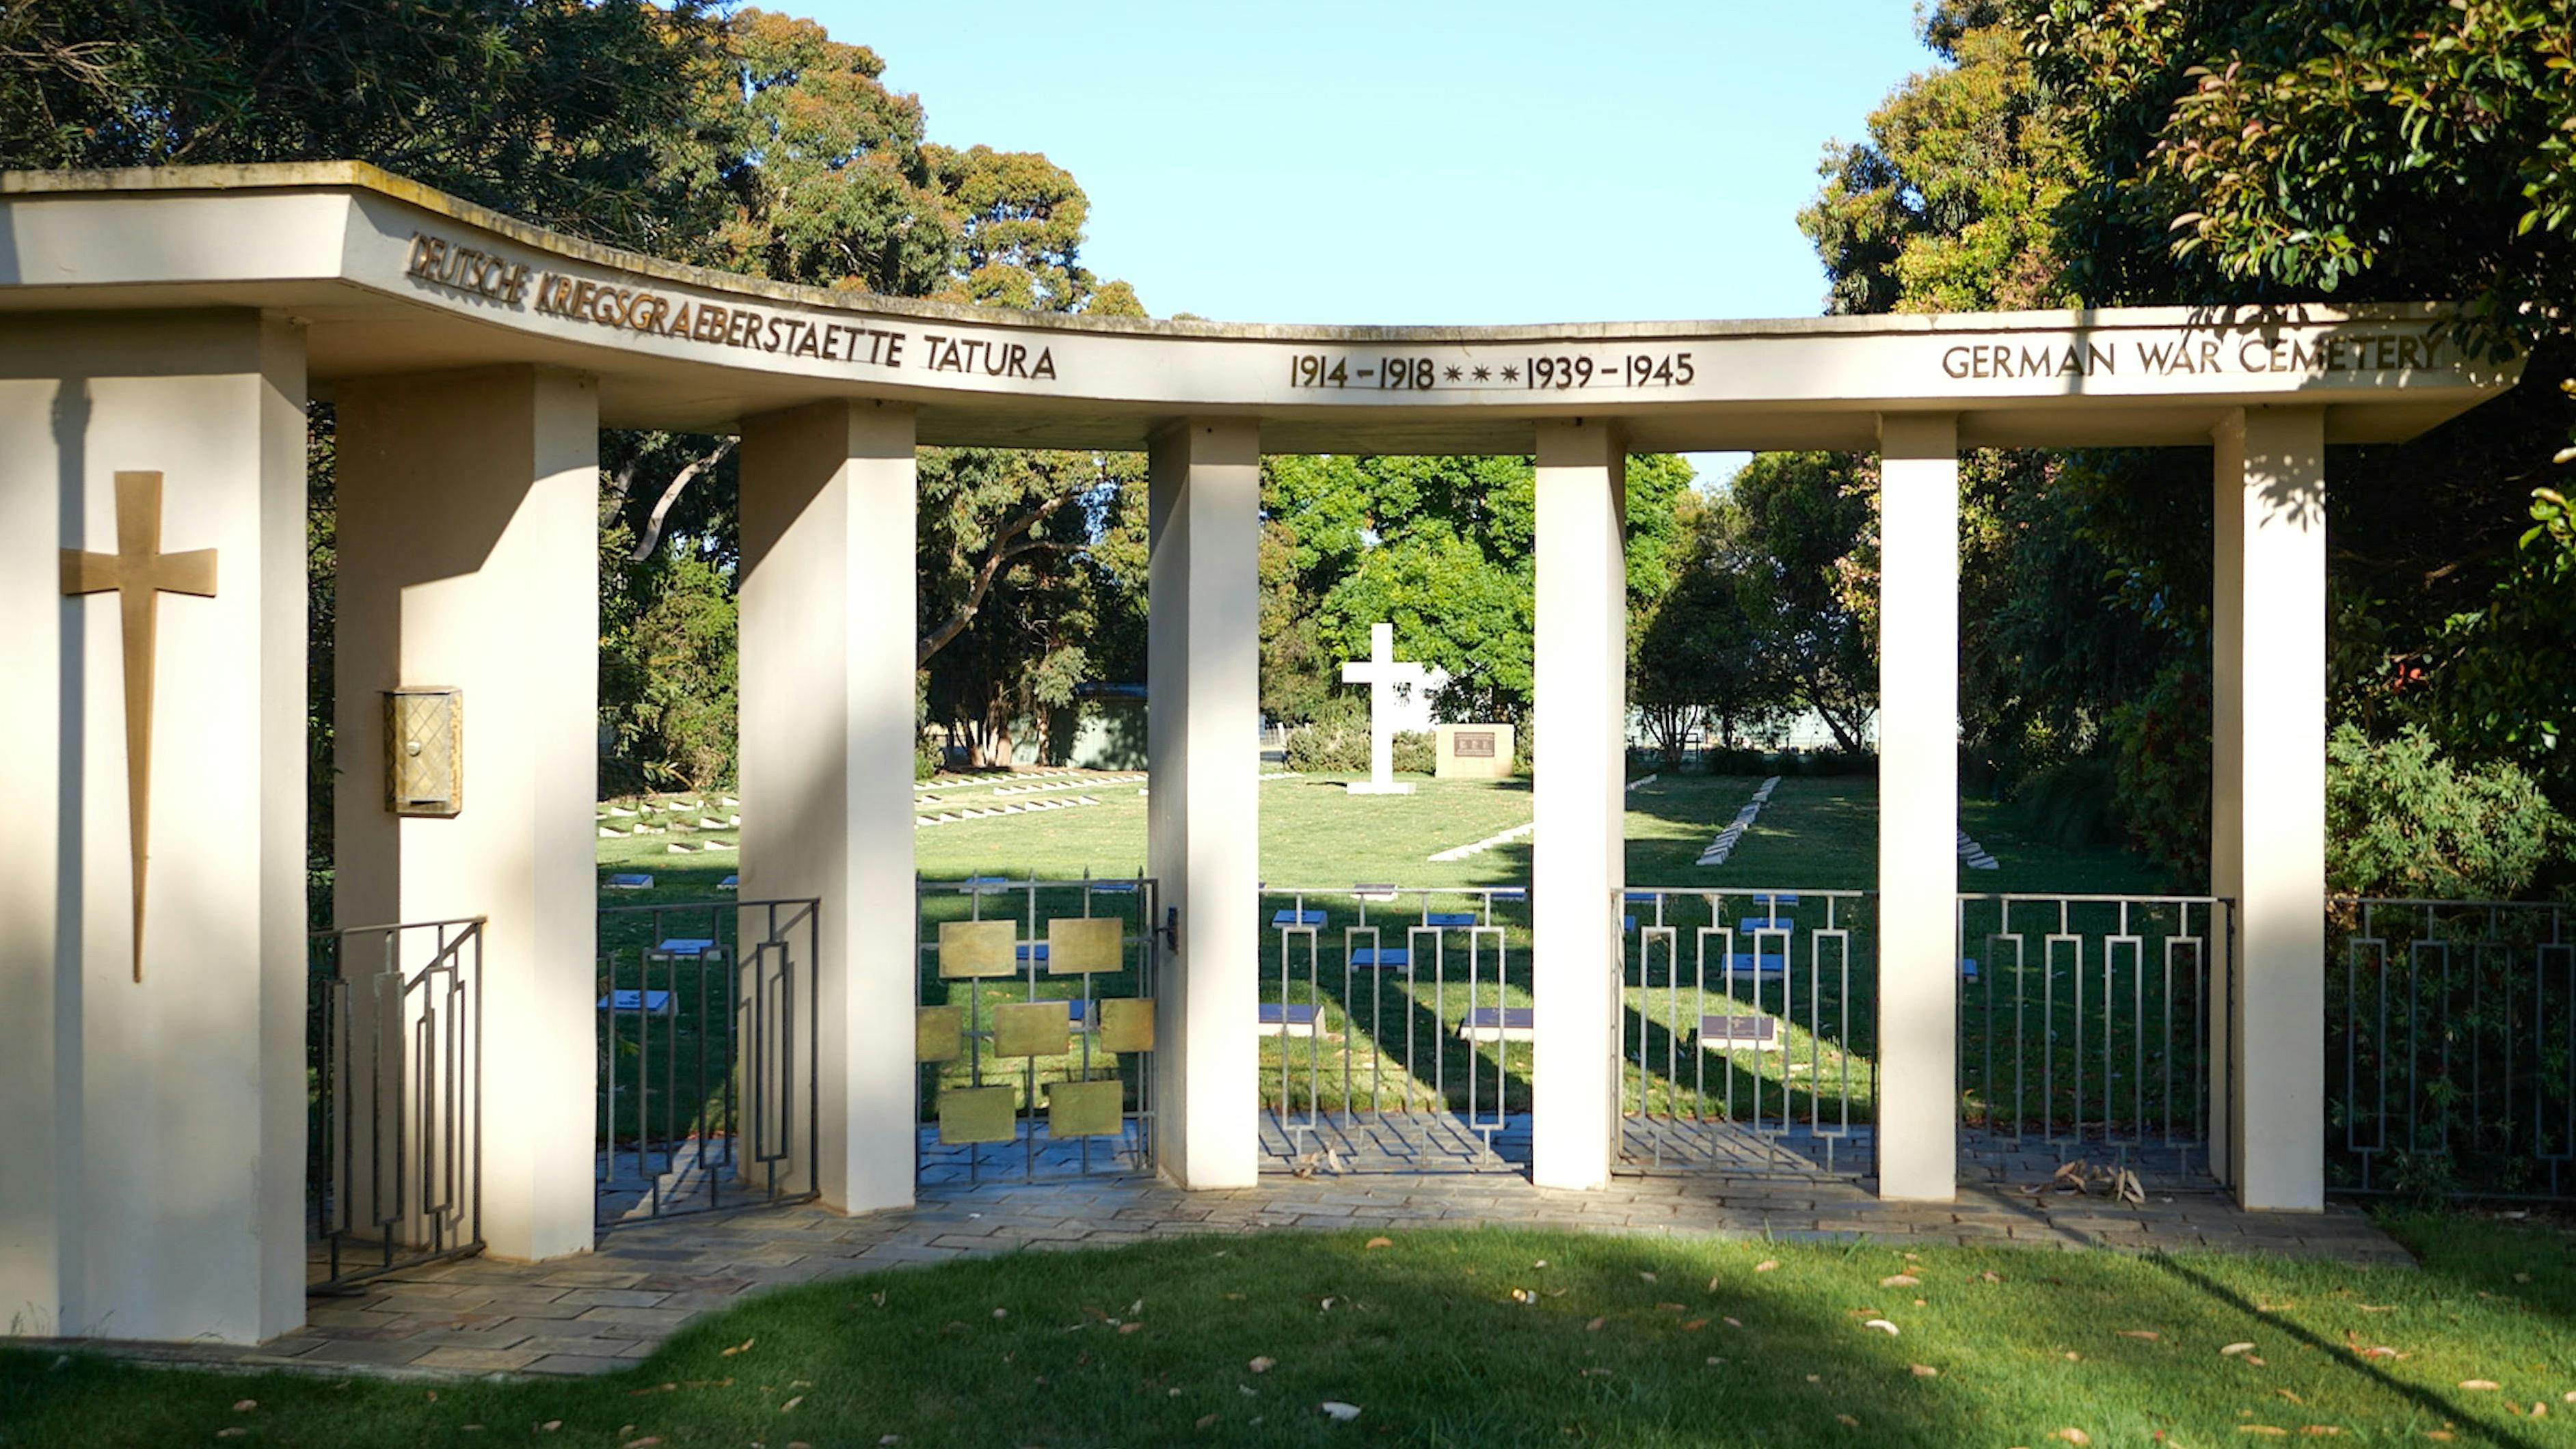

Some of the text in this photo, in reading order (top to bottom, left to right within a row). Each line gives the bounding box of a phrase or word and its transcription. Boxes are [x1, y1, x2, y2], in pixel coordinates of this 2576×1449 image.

[407, 232, 1057, 380] DEUTSCHE KRIEGSGRAEBERSTAETTE TATURA
[1942, 334, 2441, 379] GERMAN WAR CEMETERY
